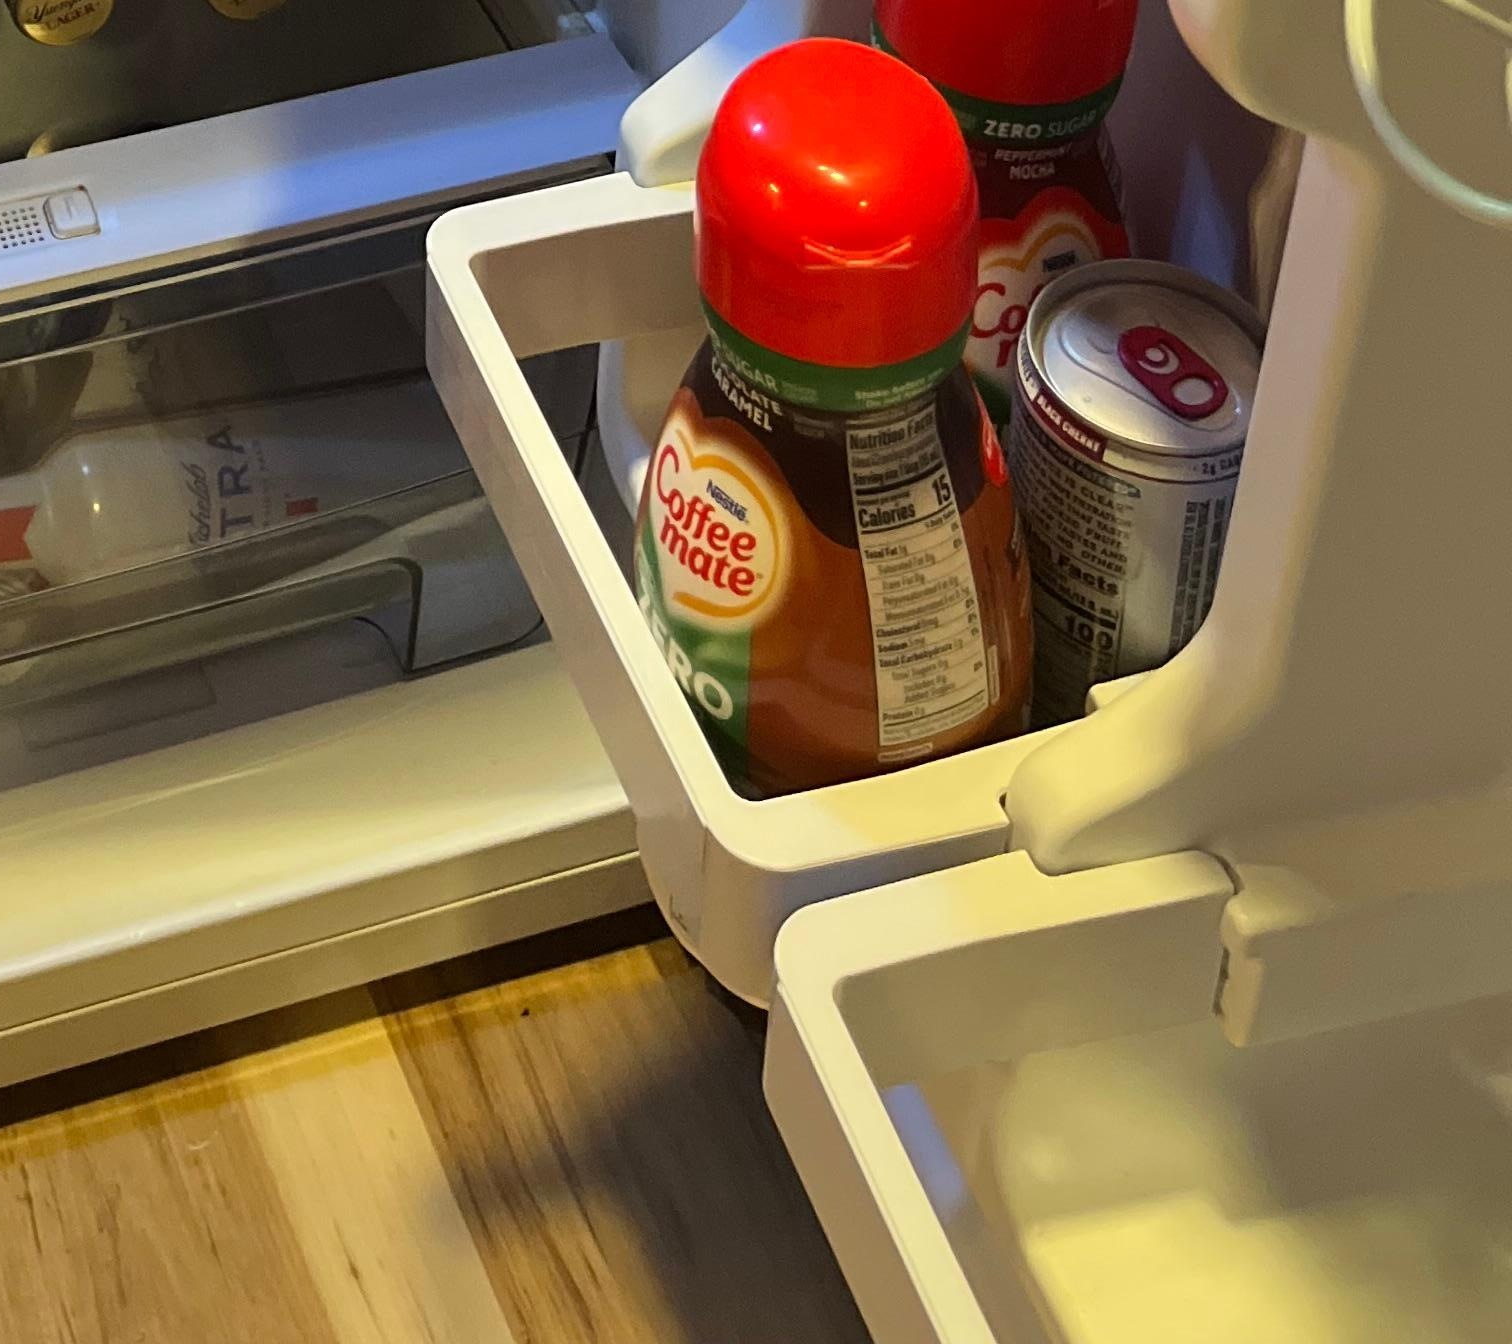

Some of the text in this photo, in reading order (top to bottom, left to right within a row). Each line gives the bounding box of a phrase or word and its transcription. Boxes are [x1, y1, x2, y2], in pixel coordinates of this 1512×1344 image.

[983, 110, 1098, 140] ZERO SUGAR
[1008, 162, 1056, 181] MOCHA
[849, 426, 906, 450] Nutrition
[205, 423, 254, 540] TRA
[655, 443, 758, 563] Coffee
[857, 473, 952, 529] Calories 15
[659, 519, 758, 598] mate
